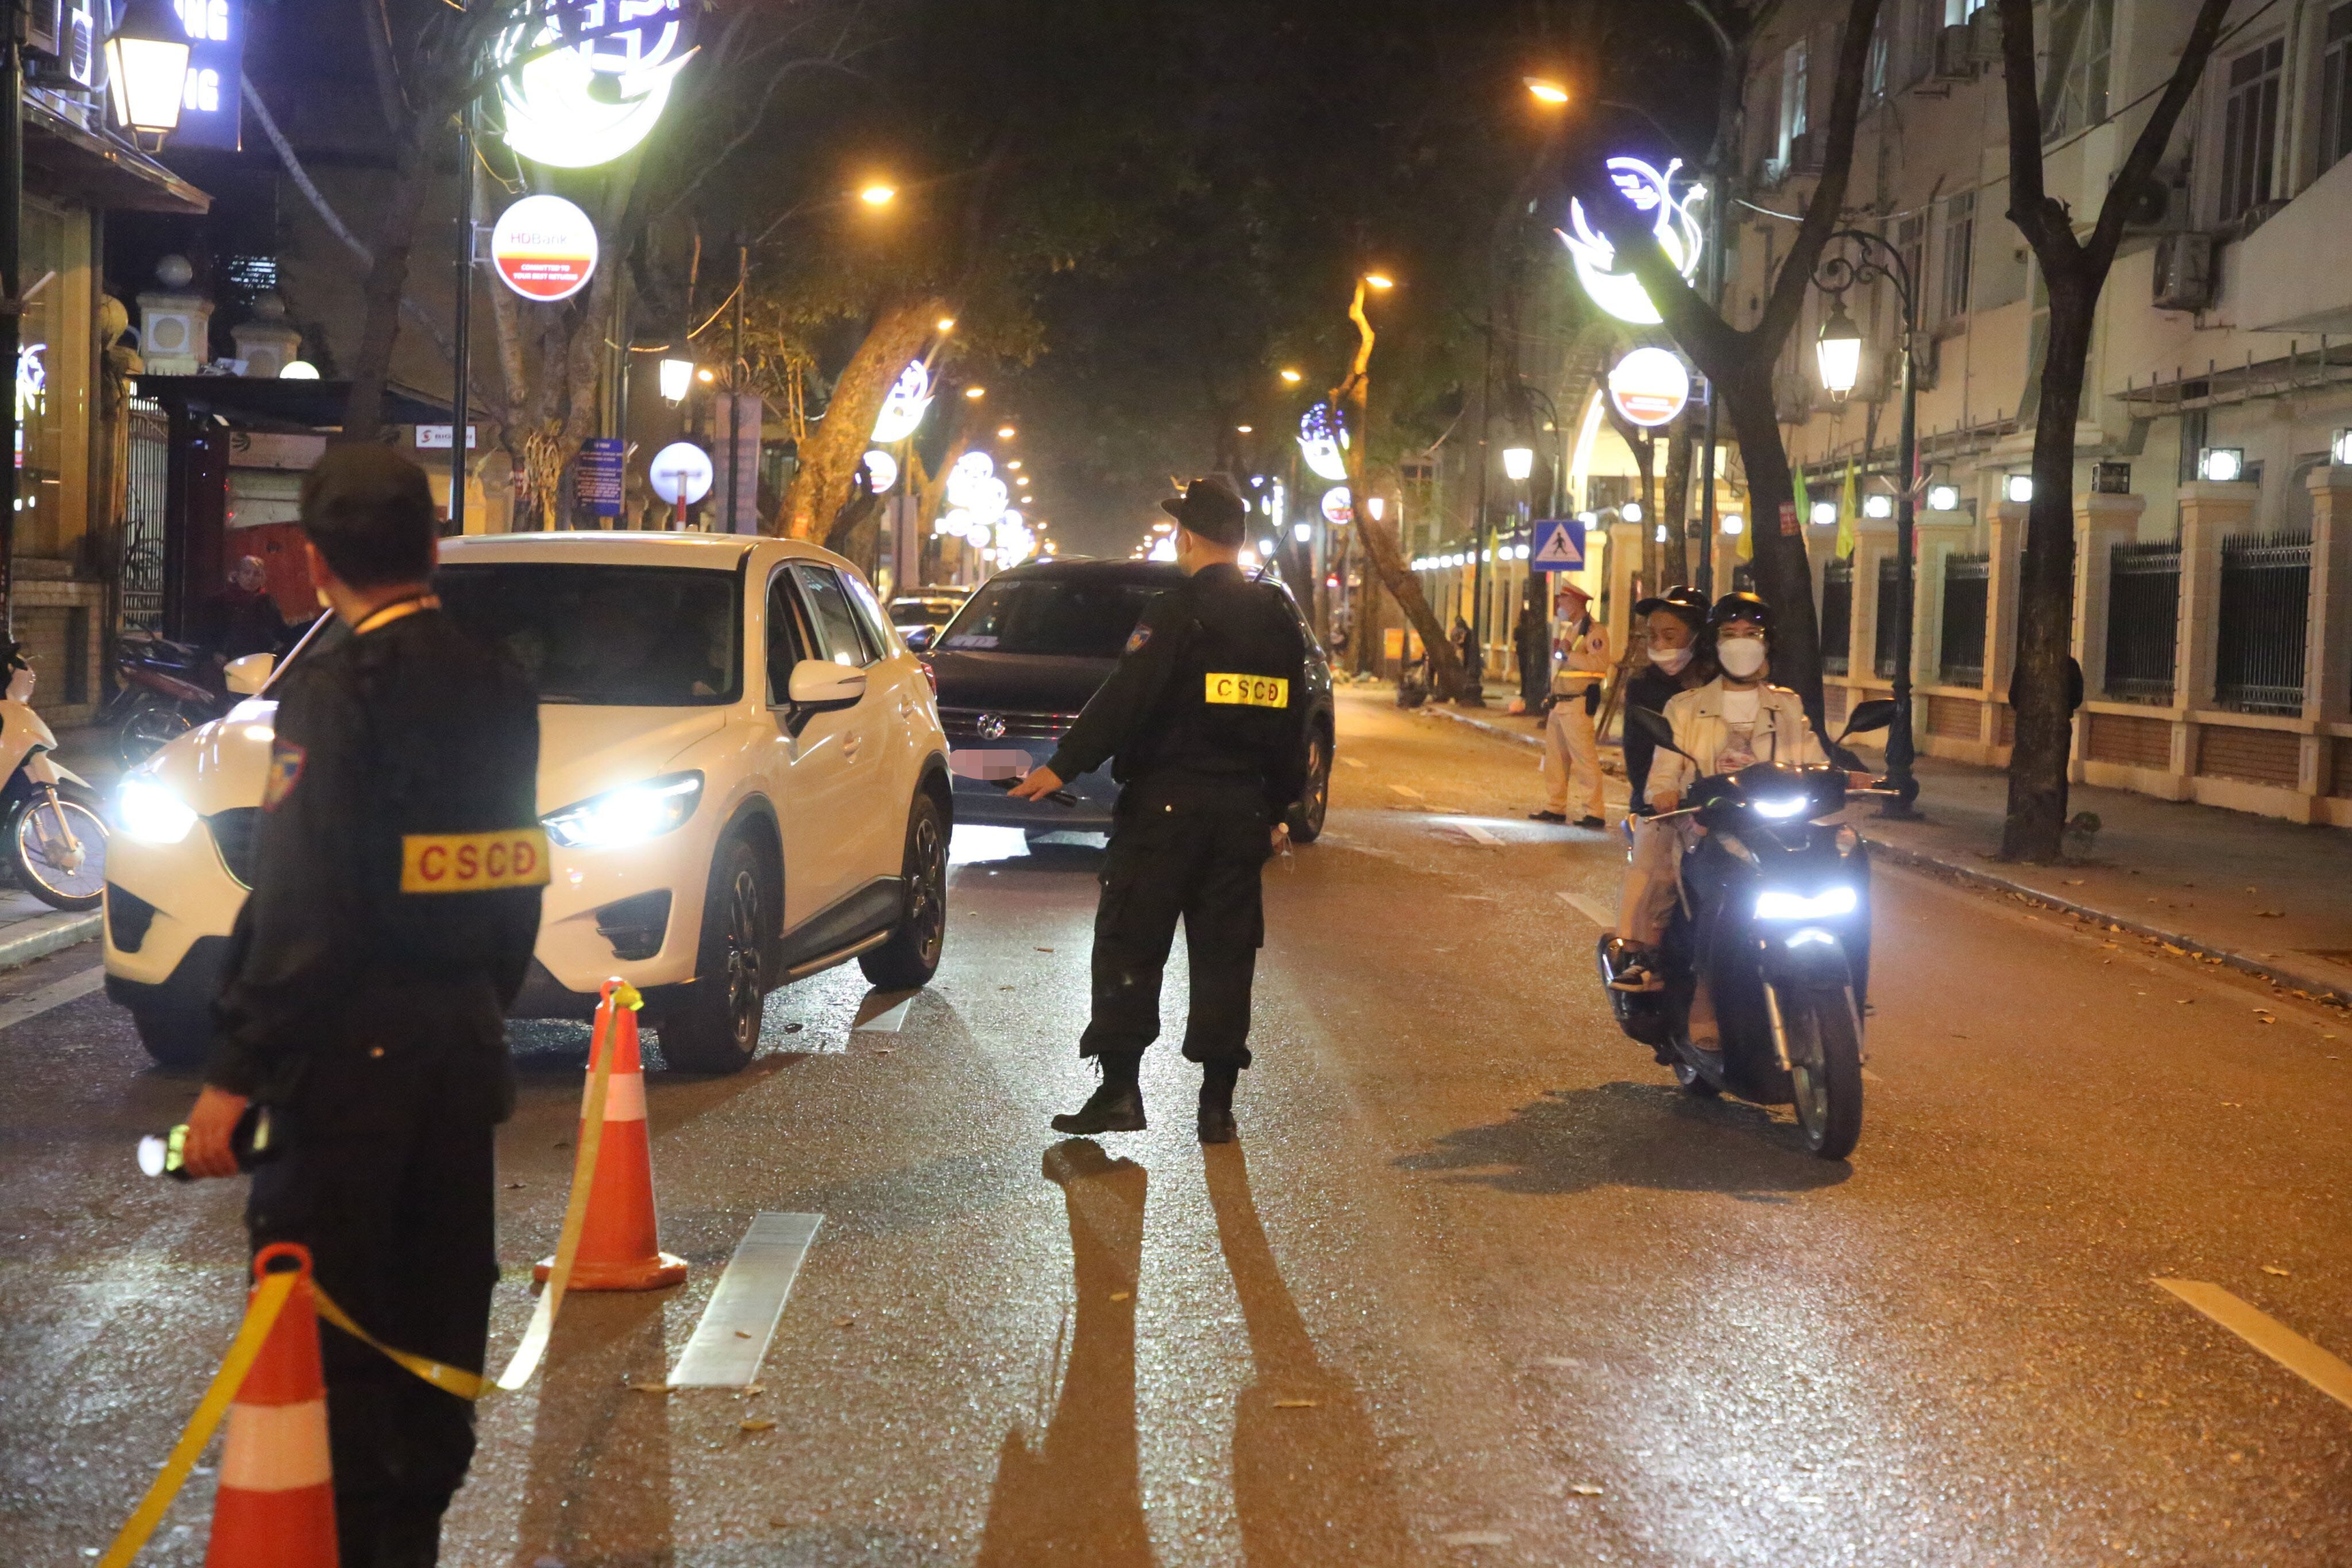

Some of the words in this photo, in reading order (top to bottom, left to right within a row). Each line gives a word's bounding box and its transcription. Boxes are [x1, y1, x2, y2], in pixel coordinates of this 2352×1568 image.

[511, 232, 567, 244] HDBank
[1217, 679, 1279, 701] CSCĐ
[419, 840, 536, 882] CSCĐ
